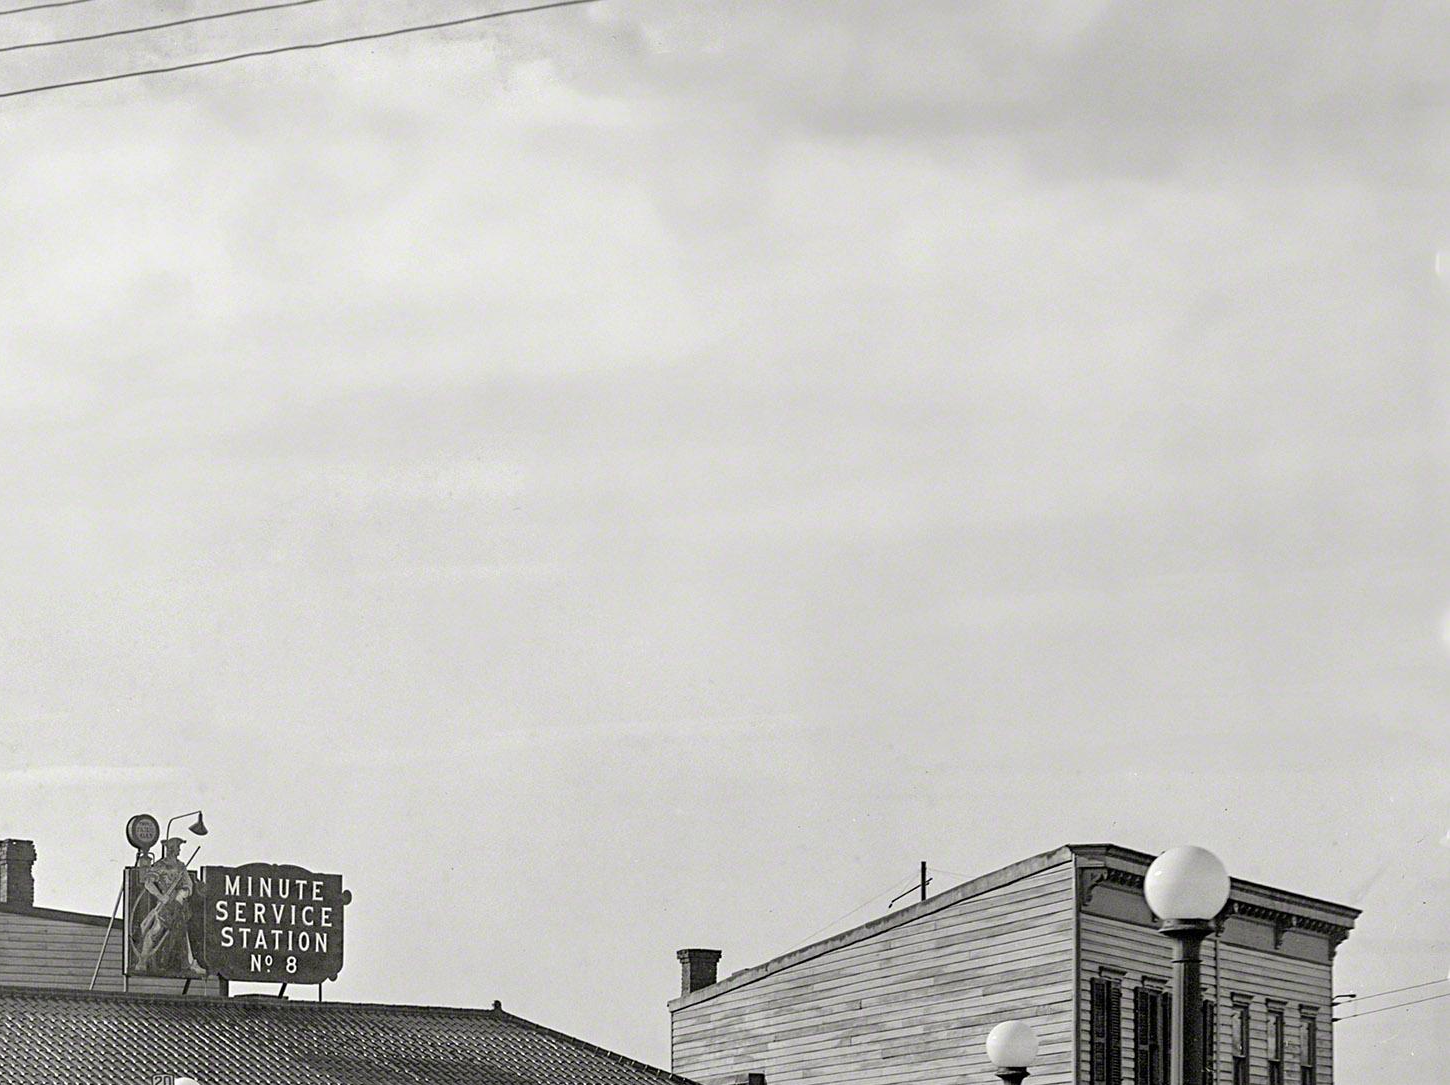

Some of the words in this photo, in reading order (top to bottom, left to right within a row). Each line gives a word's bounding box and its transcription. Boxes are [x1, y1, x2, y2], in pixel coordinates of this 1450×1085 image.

[225, 875, 324, 901] MINUTE
[216, 901, 332, 927] SERVICE
[221, 927, 327, 953] STATION
[286, 956, 297, 973] 8
